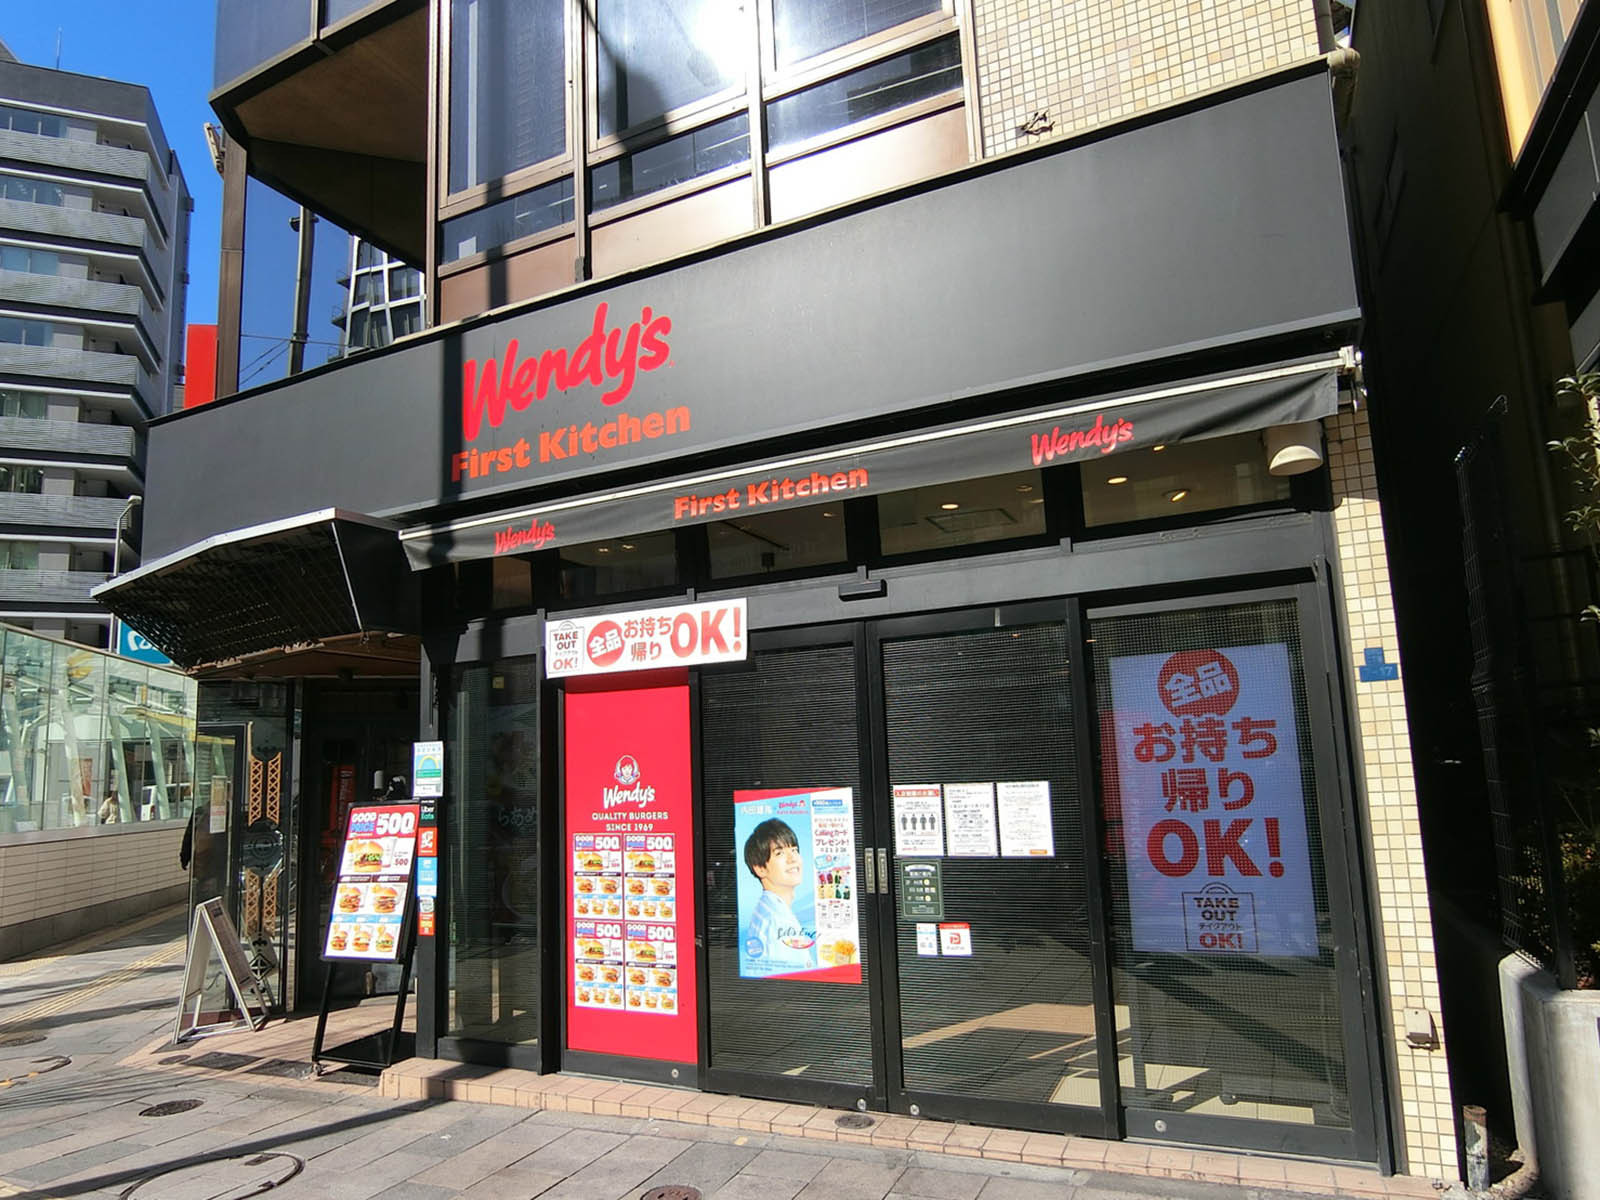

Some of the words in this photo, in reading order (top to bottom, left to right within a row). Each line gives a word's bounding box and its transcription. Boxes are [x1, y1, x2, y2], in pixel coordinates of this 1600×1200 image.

[463, 302, 672, 442] Wendy's
[452, 438, 531, 482] First
[539, 405, 691, 462] Kitchen
[1031, 414, 1133, 466] Wendy's
[674, 488, 741, 520] First
[746, 468, 869, 506] Kitchen
[494, 518, 556, 555] Wendy's
[553, 631, 579, 641] TAKE
[624, 616, 672, 639] お持ち
[670, 606, 741, 659] OK!
[557, 641, 576, 650] OUT
[588, 628, 623, 659] 全品
[630, 641, 662, 662] 帰り
[553, 657, 578, 670] OK!
[1164, 661, 1233, 707] 全品
[1132, 716, 1278, 763] お持ち
[603, 781, 655, 809] Wendy's
[1161, 767, 1255, 813] 帰り
[592, 812, 627, 821] QUALITY
[629, 812, 668, 820] BURGERS
[606, 823, 632, 832] SINCE
[634, 823, 654, 831] 1969
[1147, 817, 1285, 878] OK!
[1193, 897, 1240, 908] TAKE
[1201, 910, 1237, 921] OUT
[1199, 933, 1243, 949] OK!
